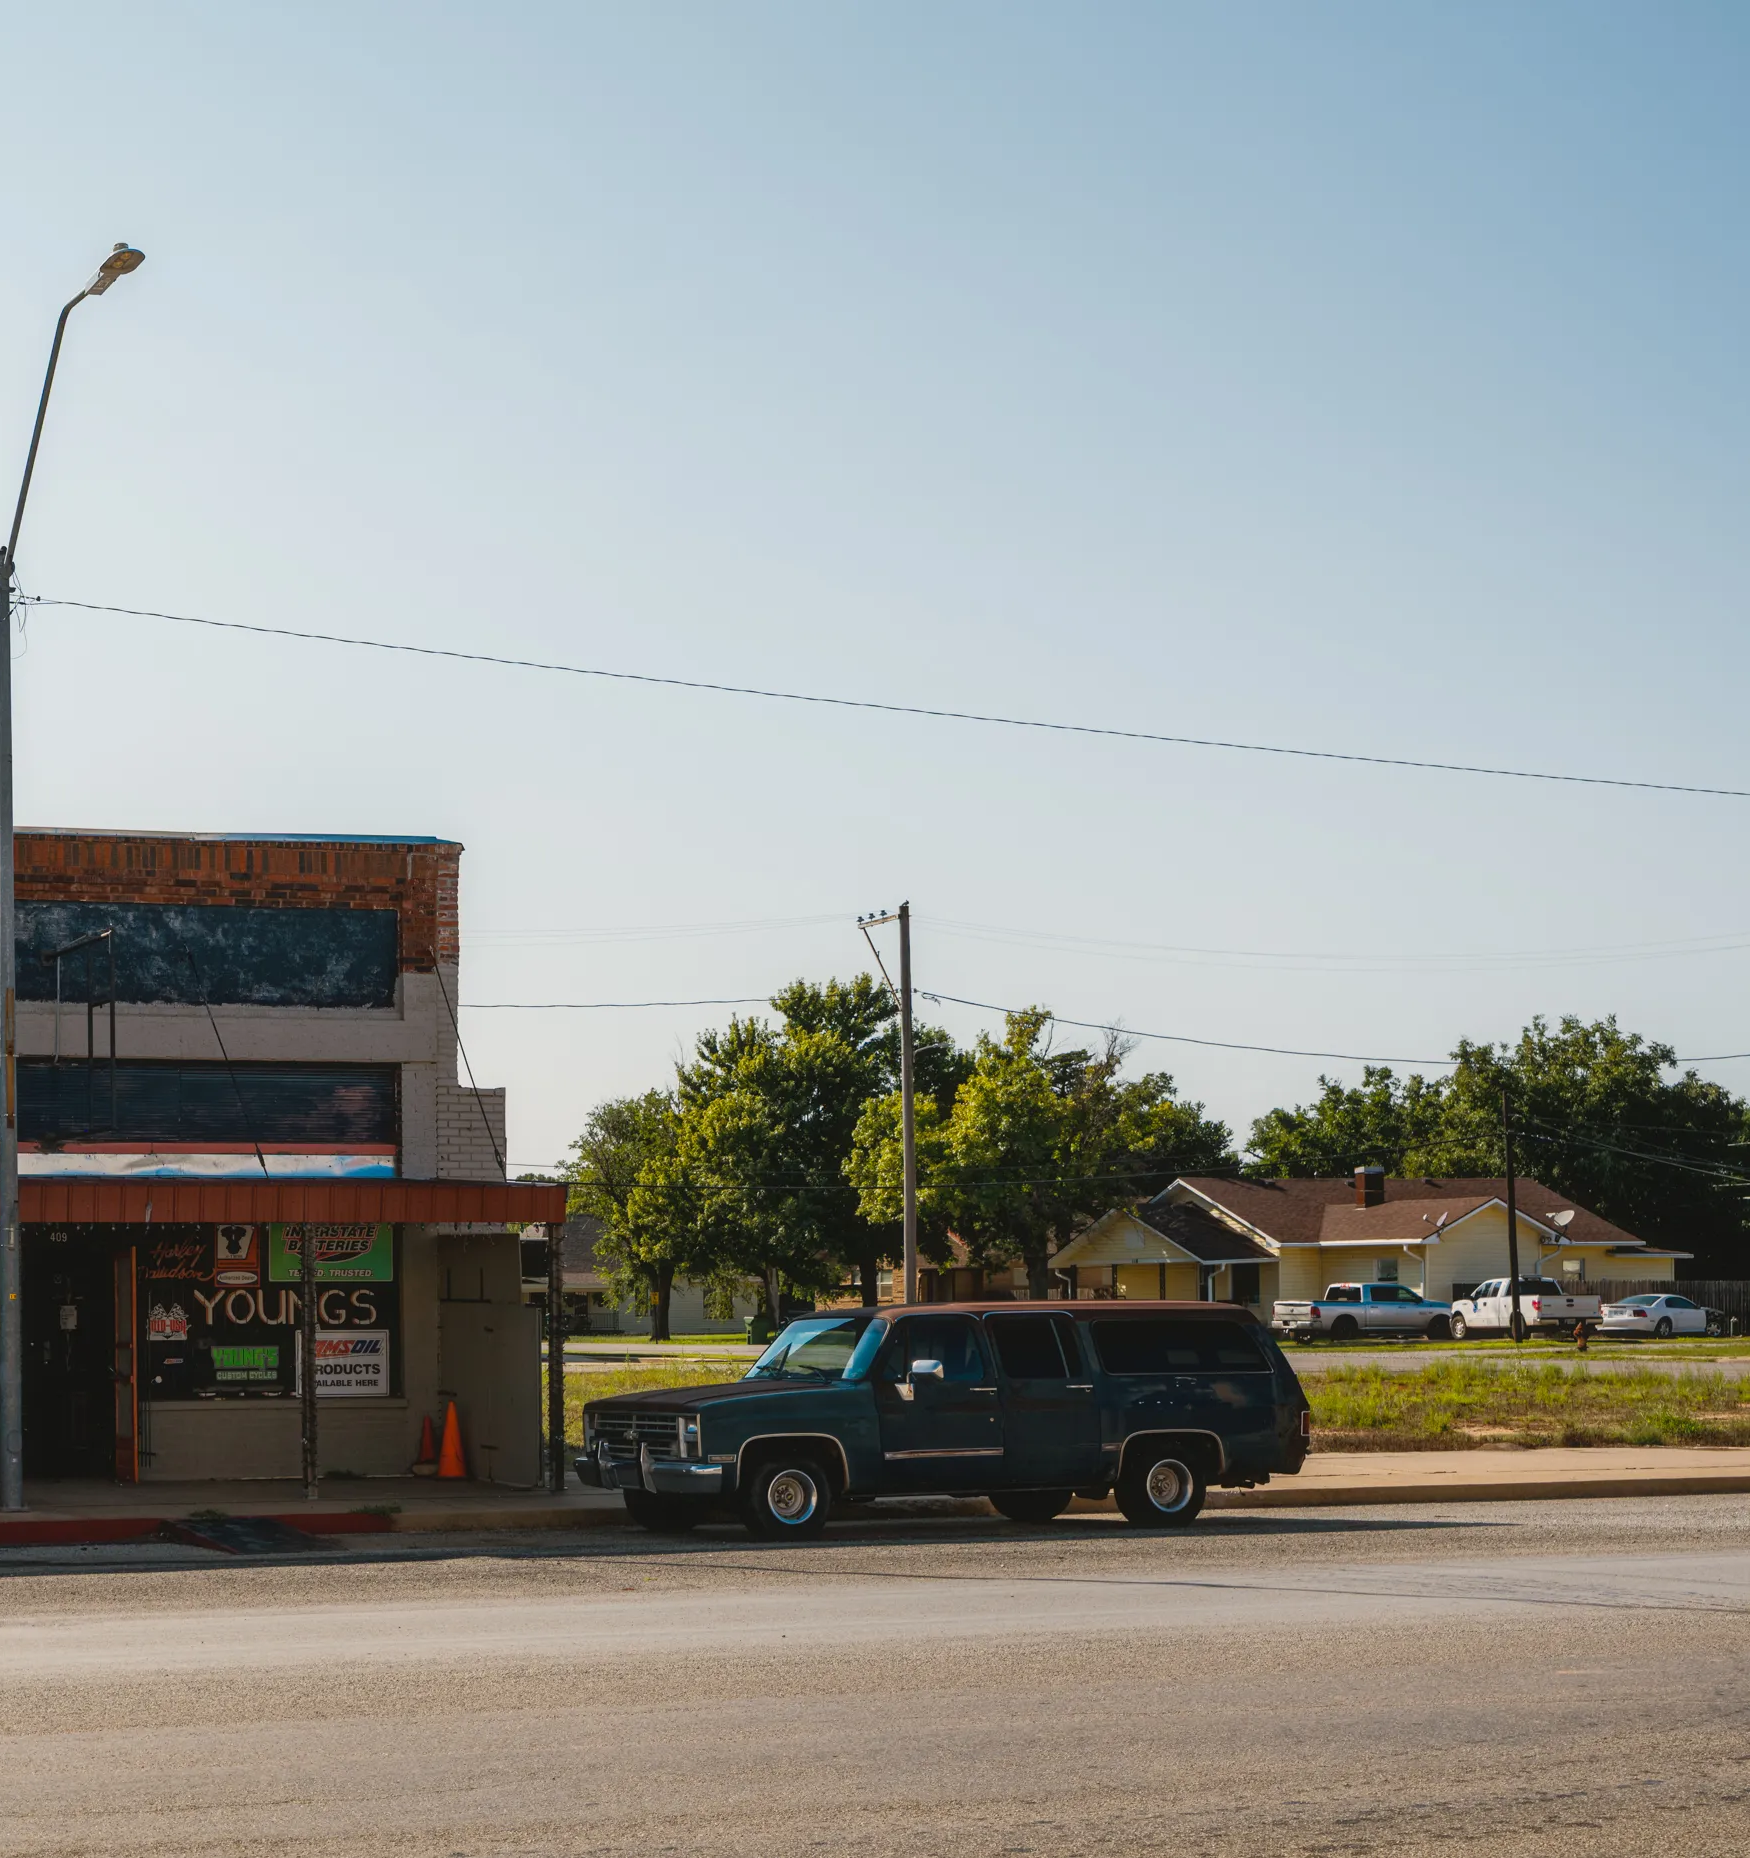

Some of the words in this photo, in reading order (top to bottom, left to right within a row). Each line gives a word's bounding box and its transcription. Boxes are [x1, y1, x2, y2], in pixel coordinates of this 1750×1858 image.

[50, 1232, 68, 1242] 409
[285, 1226, 376, 1237] INERSTATE
[149, 1236, 208, 1268] Harley
[329, 1269, 374, 1277] TRUSTED.
[213, 1347, 278, 1368] YOUNG'S
[315, 1364, 381, 1375] RODUCTS
[216, 1371, 248, 1381] CUSTOM
[249, 1370, 278, 1380] CYCLES
[316, 1379, 352, 1387] AILABLE
[355, 1379, 379, 1387] HERE
